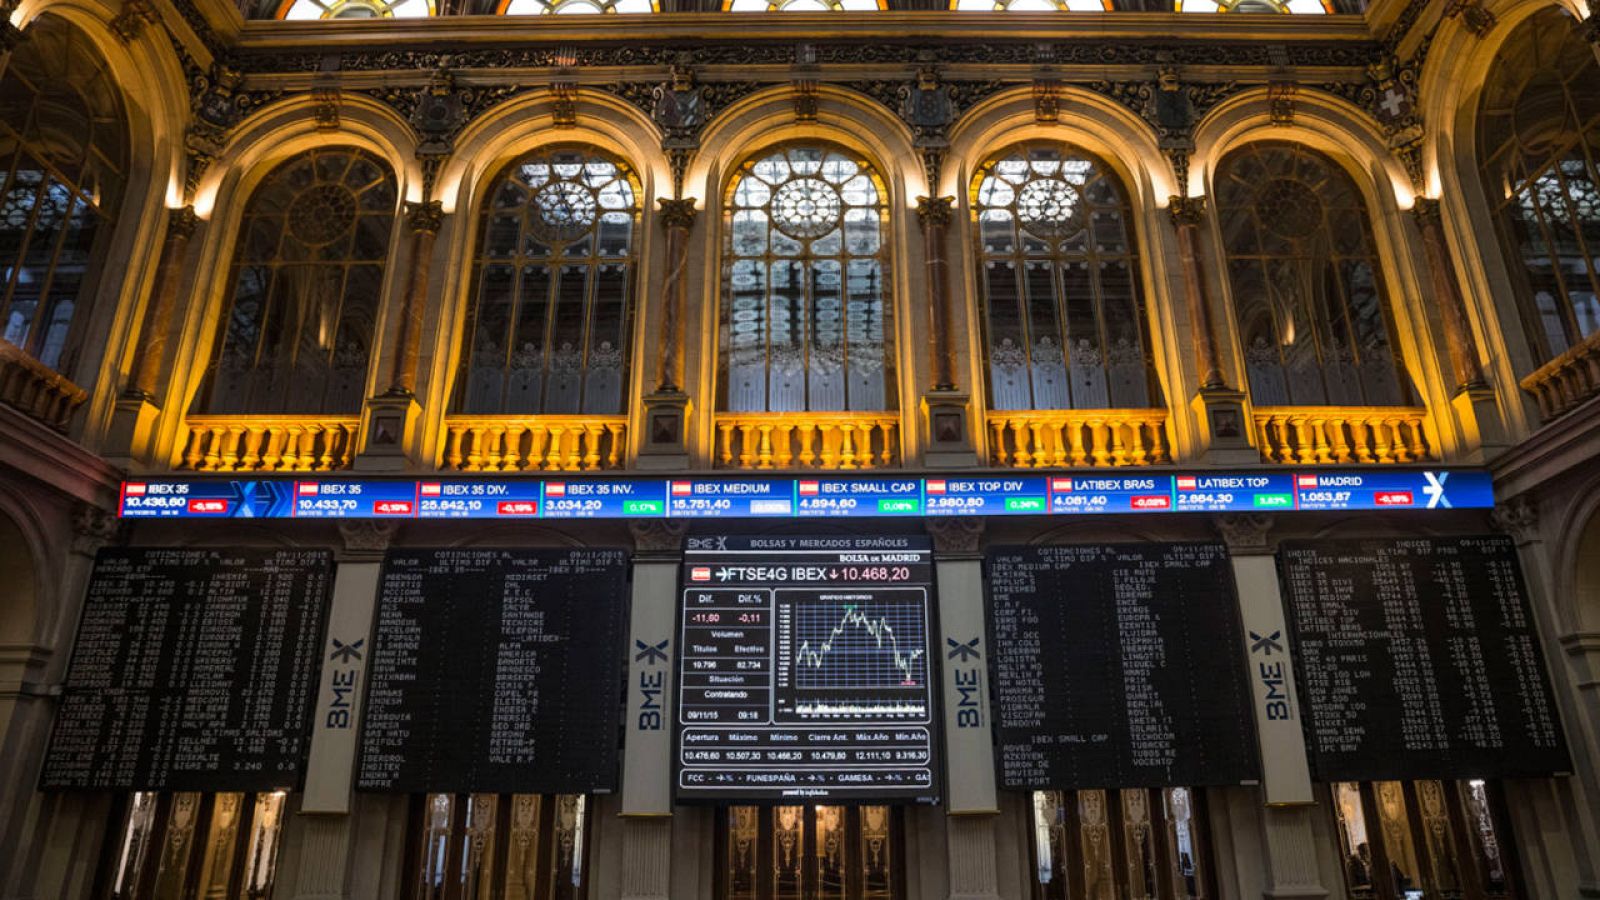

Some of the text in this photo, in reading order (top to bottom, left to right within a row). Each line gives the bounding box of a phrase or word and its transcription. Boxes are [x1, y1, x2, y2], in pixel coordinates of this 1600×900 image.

[1074, 480, 1155, 490] LATIBEX BRAS
[1198, 478, 1269, 488] LATIBEX TOP
[1319, 476, 1362, 486] MADRID
[148, 484, 190, 494] IBEX 35
[320, 484, 362, 494] IBEX 35
[443, 485, 510, 495] IBEX 35 DIV.
[568, 484, 635, 494] IBEX 35 INV.
[694, 483, 770, 493] IBEX MEDIUM
[821, 483, 916, 493] IBEX SMALL CAP
[948, 482, 1023, 492] IBEX TOP DIV
[545, 500, 603, 510] 3.034,20
[750, 538, 908, 548] BOLSAS Y MERCADOS ESPAÑOLES
[840, 554, 870, 562] BOLSA
[882, 554, 920, 562] MADRID
[728, 567, 827, 581] FTSE4G IBEX
[842, 567, 910, 582] 10.468,20
[698, 594, 714, 604] Dif.
[738, 614, 760, 622] -0,11
[711, 630, 744, 638] Volumen
[709, 674, 744, 683] Situación
[704, 690, 748, 699] Contratando
[1260, 661, 1289, 720] BME
[326, 669, 355, 728] BME
[638, 671, 662, 730] BME
[955, 669, 980, 728] BME
[687, 711, 718, 720] 09/11/15
[738, 711, 758, 720] 09:18
[685, 734, 720, 742] Apertura
[687, 774, 704, 782] FCC
[746, 773, 796, 782] FUNESPAÑA
[838, 774, 874, 782] GAMESA
